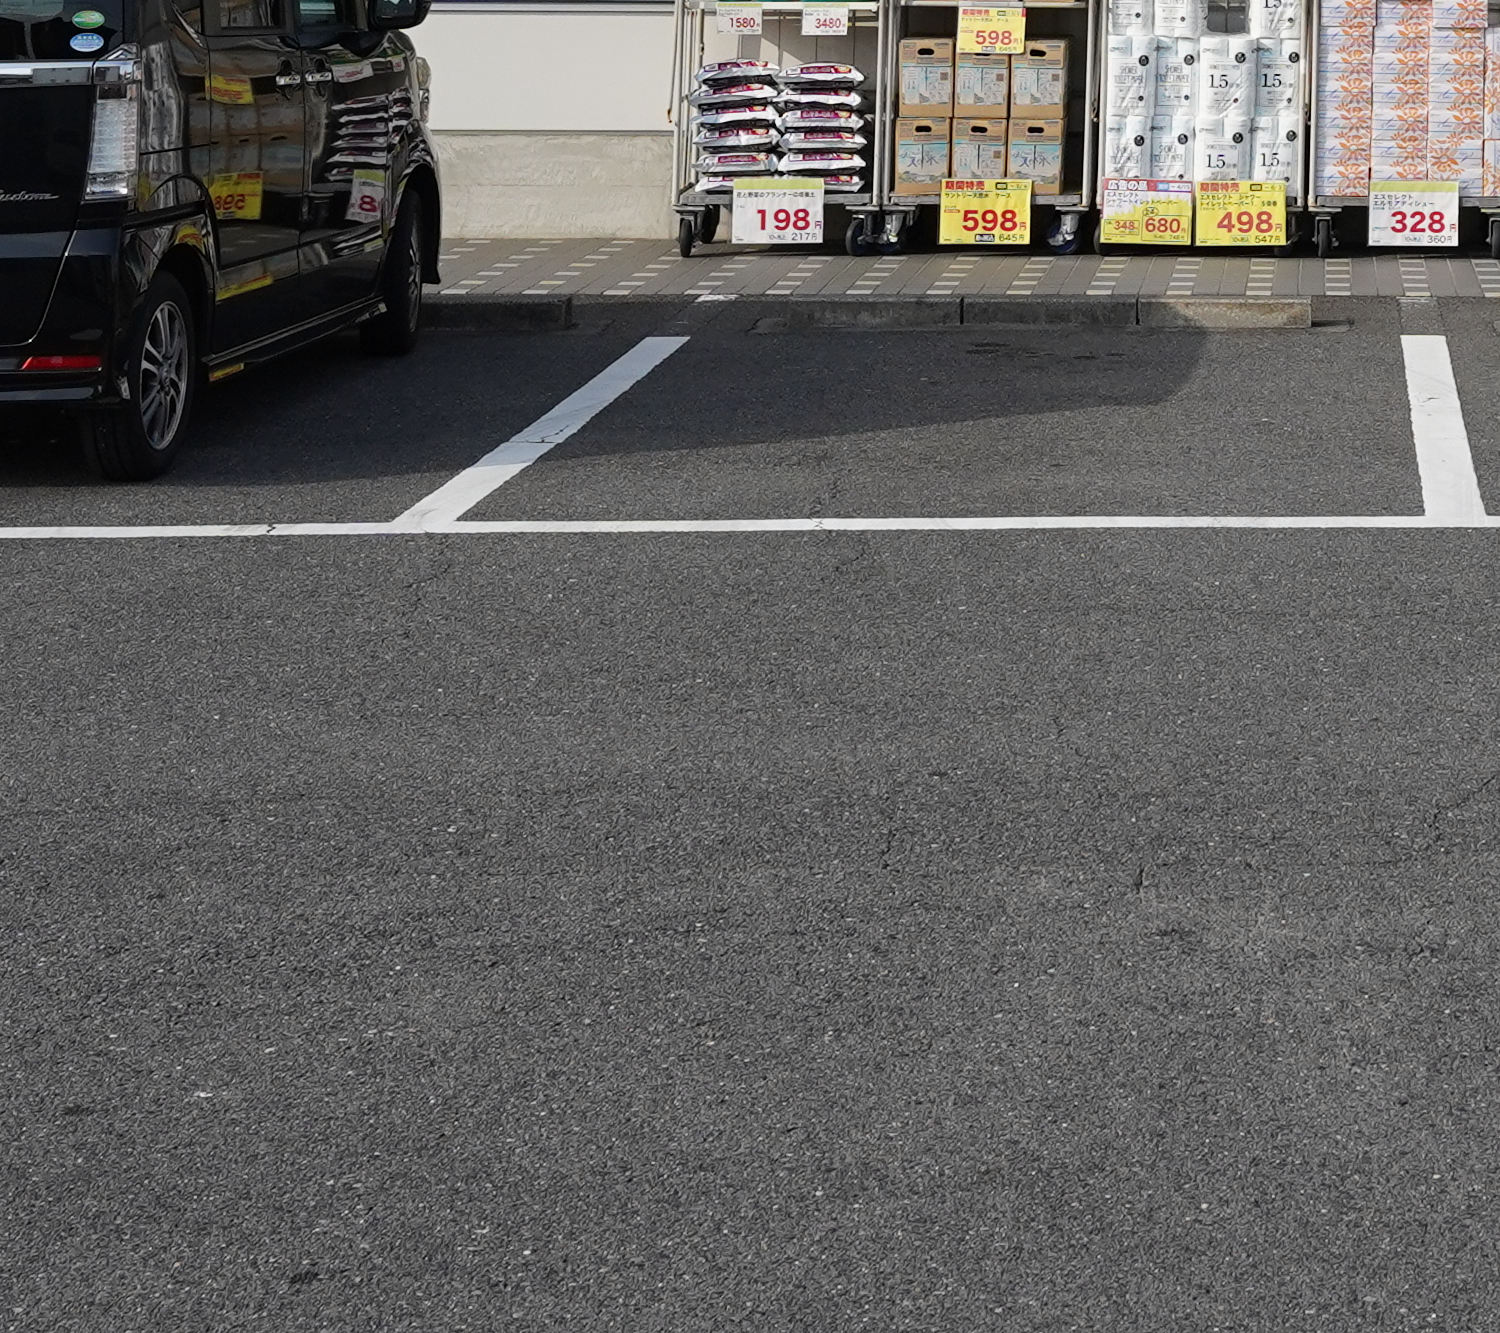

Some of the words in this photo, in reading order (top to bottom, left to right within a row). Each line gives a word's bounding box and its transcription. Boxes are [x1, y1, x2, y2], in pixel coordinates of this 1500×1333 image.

[944, 181, 985, 190] 期間特売
[1200, 182, 1239, 192] 期間特売
